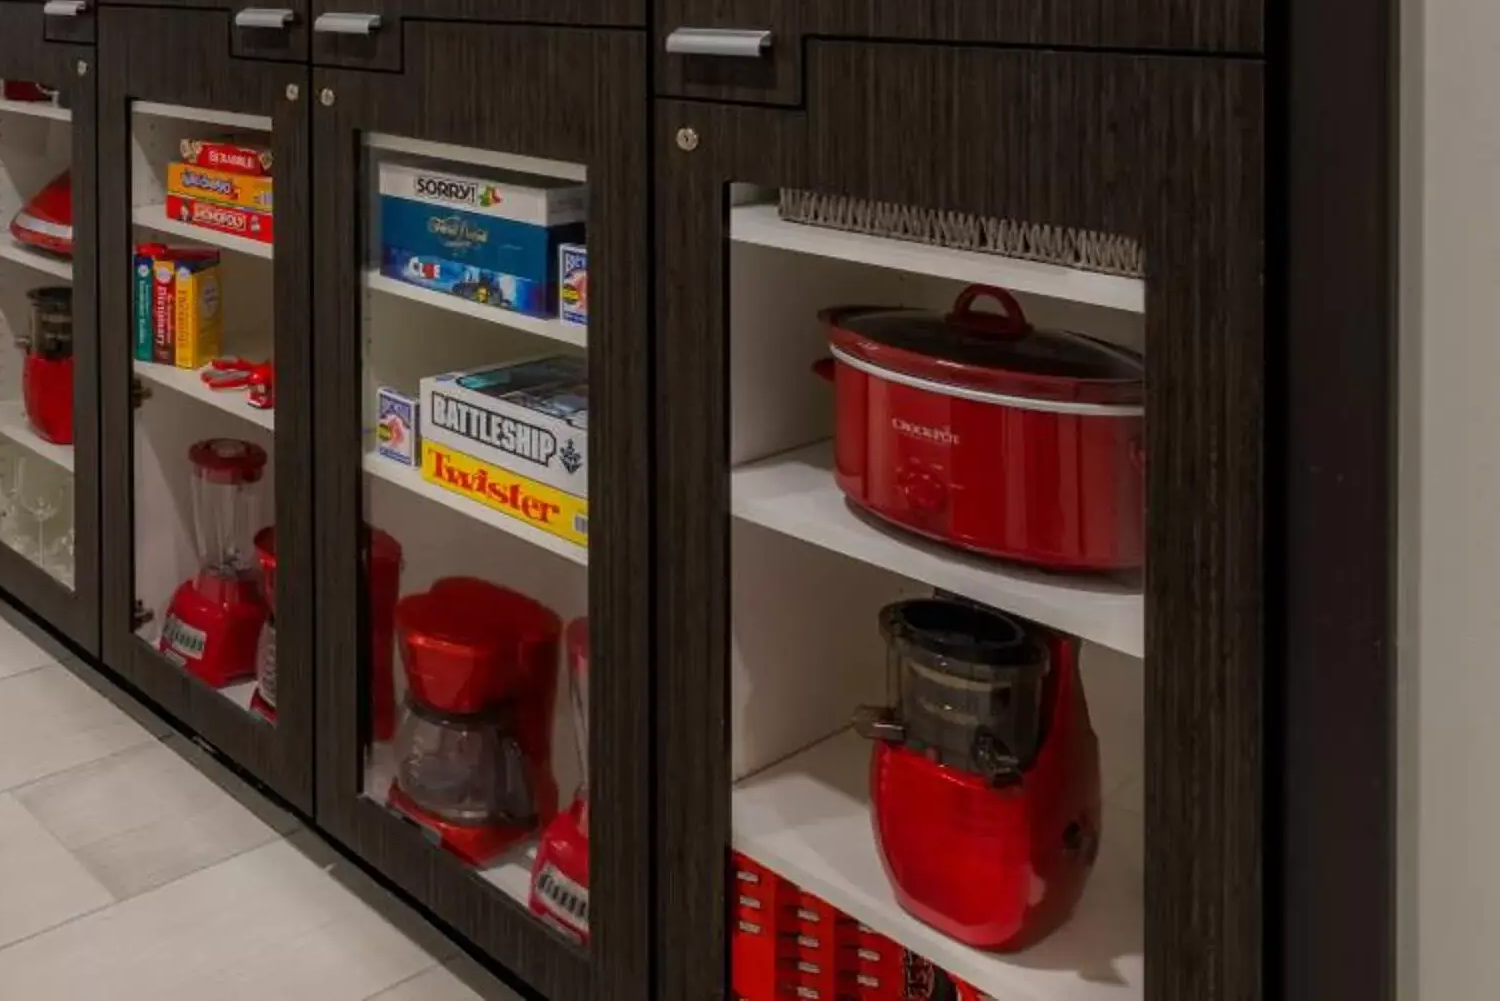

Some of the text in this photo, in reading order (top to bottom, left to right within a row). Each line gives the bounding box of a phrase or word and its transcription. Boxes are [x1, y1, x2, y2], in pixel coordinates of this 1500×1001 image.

[415, 176, 477, 205] SORRY!
[431, 390, 557, 468] BATTLESHIP
[427, 447, 561, 524] Twister
